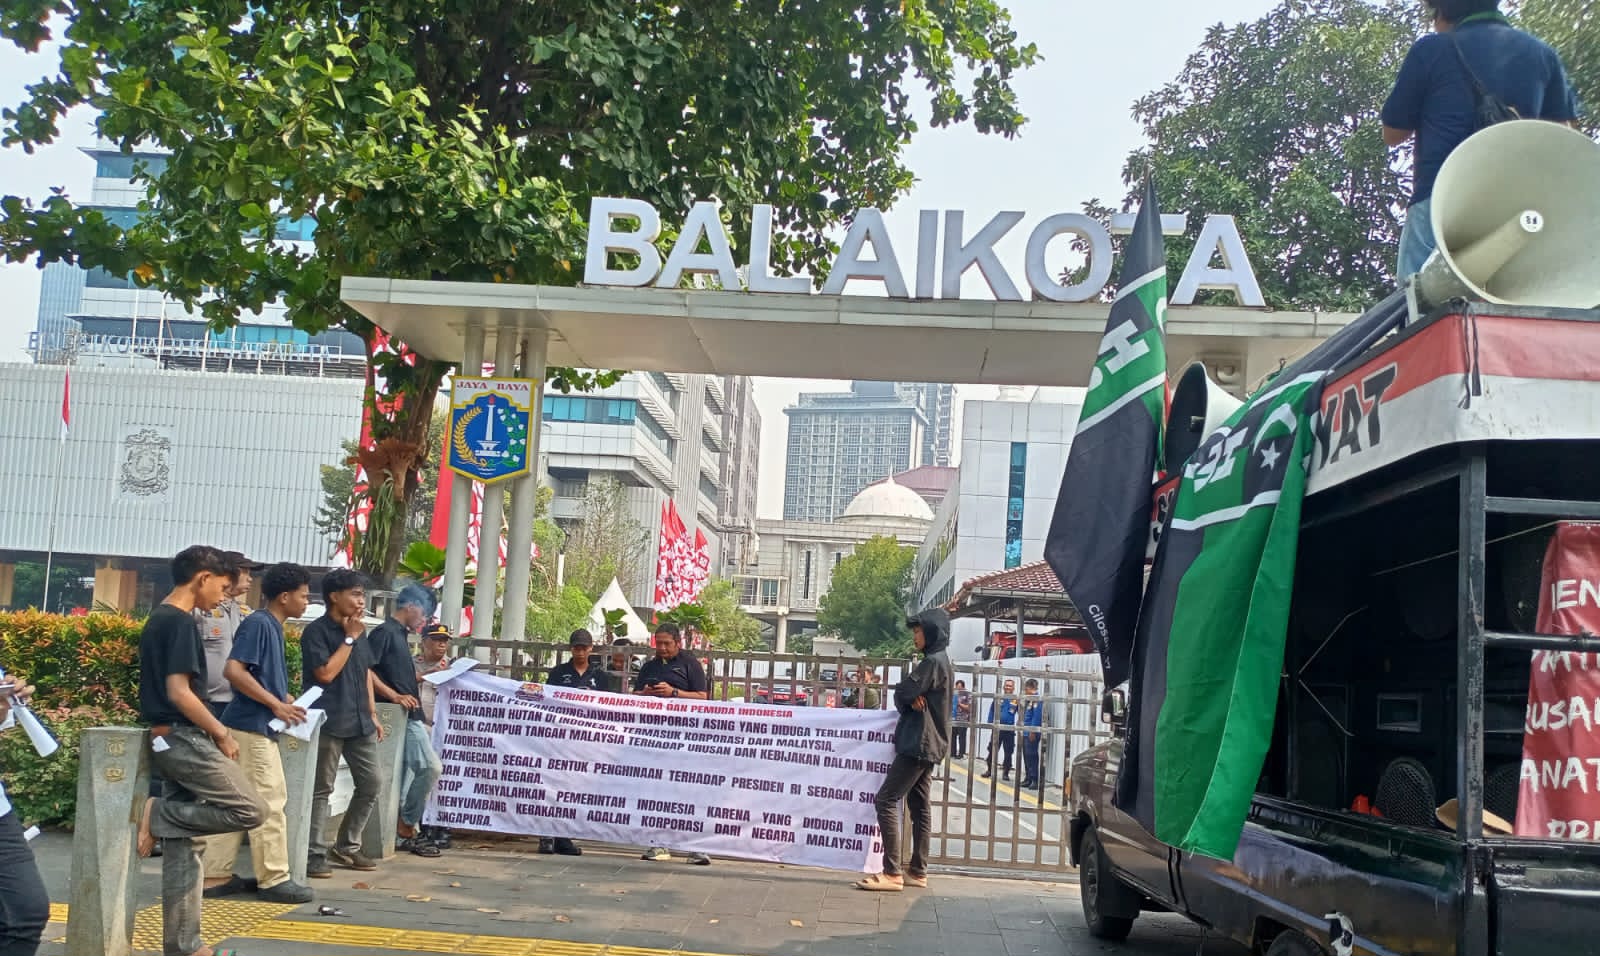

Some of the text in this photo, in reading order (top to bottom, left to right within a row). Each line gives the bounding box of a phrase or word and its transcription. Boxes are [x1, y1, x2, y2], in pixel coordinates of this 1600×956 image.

[457, 381, 488, 389] JAYA
[449, 688, 504, 704] MENDESAK
[639, 714, 699, 729] KORPORASI
[702, 718, 735, 731] ASING
[739, 720, 768, 735] YANG
[771, 723, 811, 737] DIDUGA
[815, 727, 864, 740] TERLIBAT
[449, 703, 505, 719] KEBAKARAN
[508, 708, 542, 722] HUTAN
[545, 713, 557, 724] DI
[623, 726, 681, 740] TERMASUK
[684, 731, 744, 745] KORPORASI
[747, 736, 773, 746] DARI
[776, 738, 836, 753] MALAYSIA.
[552, 690, 595, 703] SERIKAT
[598, 696, 663, 710] MAHASISWA
[666, 703, 688, 712] DAN
[690, 705, 735, 715] PEMUDA
[738, 707, 793, 718] INDONESIA
[443, 733, 496, 749] INDONESIA.
[448, 718, 474, 732] TOLAK
[477, 721, 521, 735] CAMPUR
[525, 725, 565, 740] TANGAN
[569, 729, 625, 745] MALAYSIA
[628, 736, 685, 750] TERHADAP
[687, 743, 731, 756] URUSAN
[734, 747, 758, 759] DAN
[760, 748, 820, 767] KEBIJAKAN
[823, 756, 863, 771] DALAM
[441, 749, 497, 765] MENGECAM
[502, 754, 542, 769] SEGALA
[547, 758, 588, 773] BENTUK
[593, 762, 663, 780] PENGHINAAN
[669, 769, 726, 786] TERHADAP
[731, 778, 784, 793] PRESIDEN
[790, 783, 801, 796] RI
[807, 786, 854, 802] SEBAGAI
[463, 766, 498, 780] KEPALA
[500, 769, 544, 785] NEGARA.
[437, 795, 507, 813] MENYUMBANG
[516, 802, 576, 820] KEBAKARAN
[587, 810, 630, 825] ADALAH
[641, 815, 704, 833] KORPORASI
[714, 822, 741, 837] DARI
[752, 827, 795, 844] NEGARA
[806, 833, 863, 851] MALAYSIA
[438, 780, 463, 792] STOP
[473, 782, 546, 801] MENYALAHKAN
[556, 791, 626, 809] PEMERINTAH
[636, 798, 695, 816] INDONESIA
[707, 806, 750, 822] KARENA
[763, 812, 792, 826] YANG
[803, 817, 843, 833] DIDUGA
